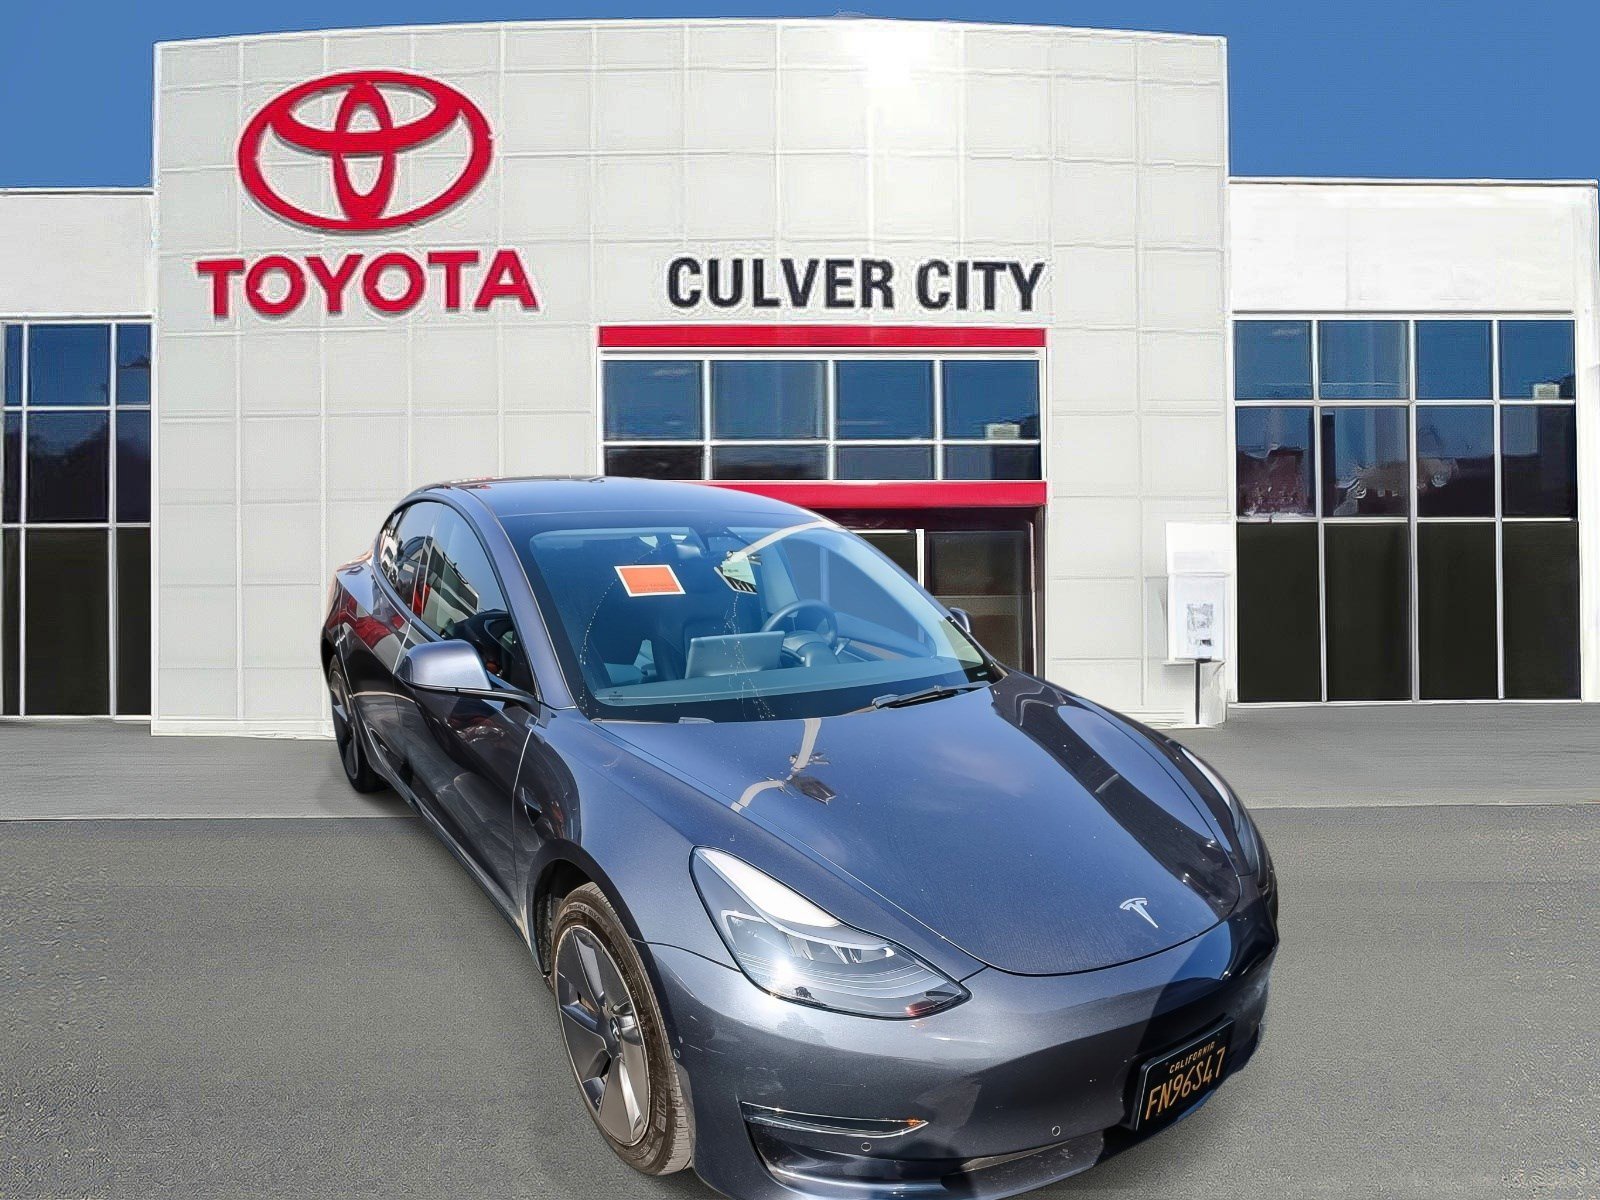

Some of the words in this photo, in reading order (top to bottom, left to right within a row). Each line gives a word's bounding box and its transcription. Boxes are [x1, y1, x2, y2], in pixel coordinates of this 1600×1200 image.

[196, 250, 538, 316] TOYOTA
[667, 257, 895, 309] CULVER
[916, 259, 1046, 311] CITY
[1145, 1046, 1226, 1121] FN96S47
[1169, 1041, 1216, 1074] CALIFORNIA
